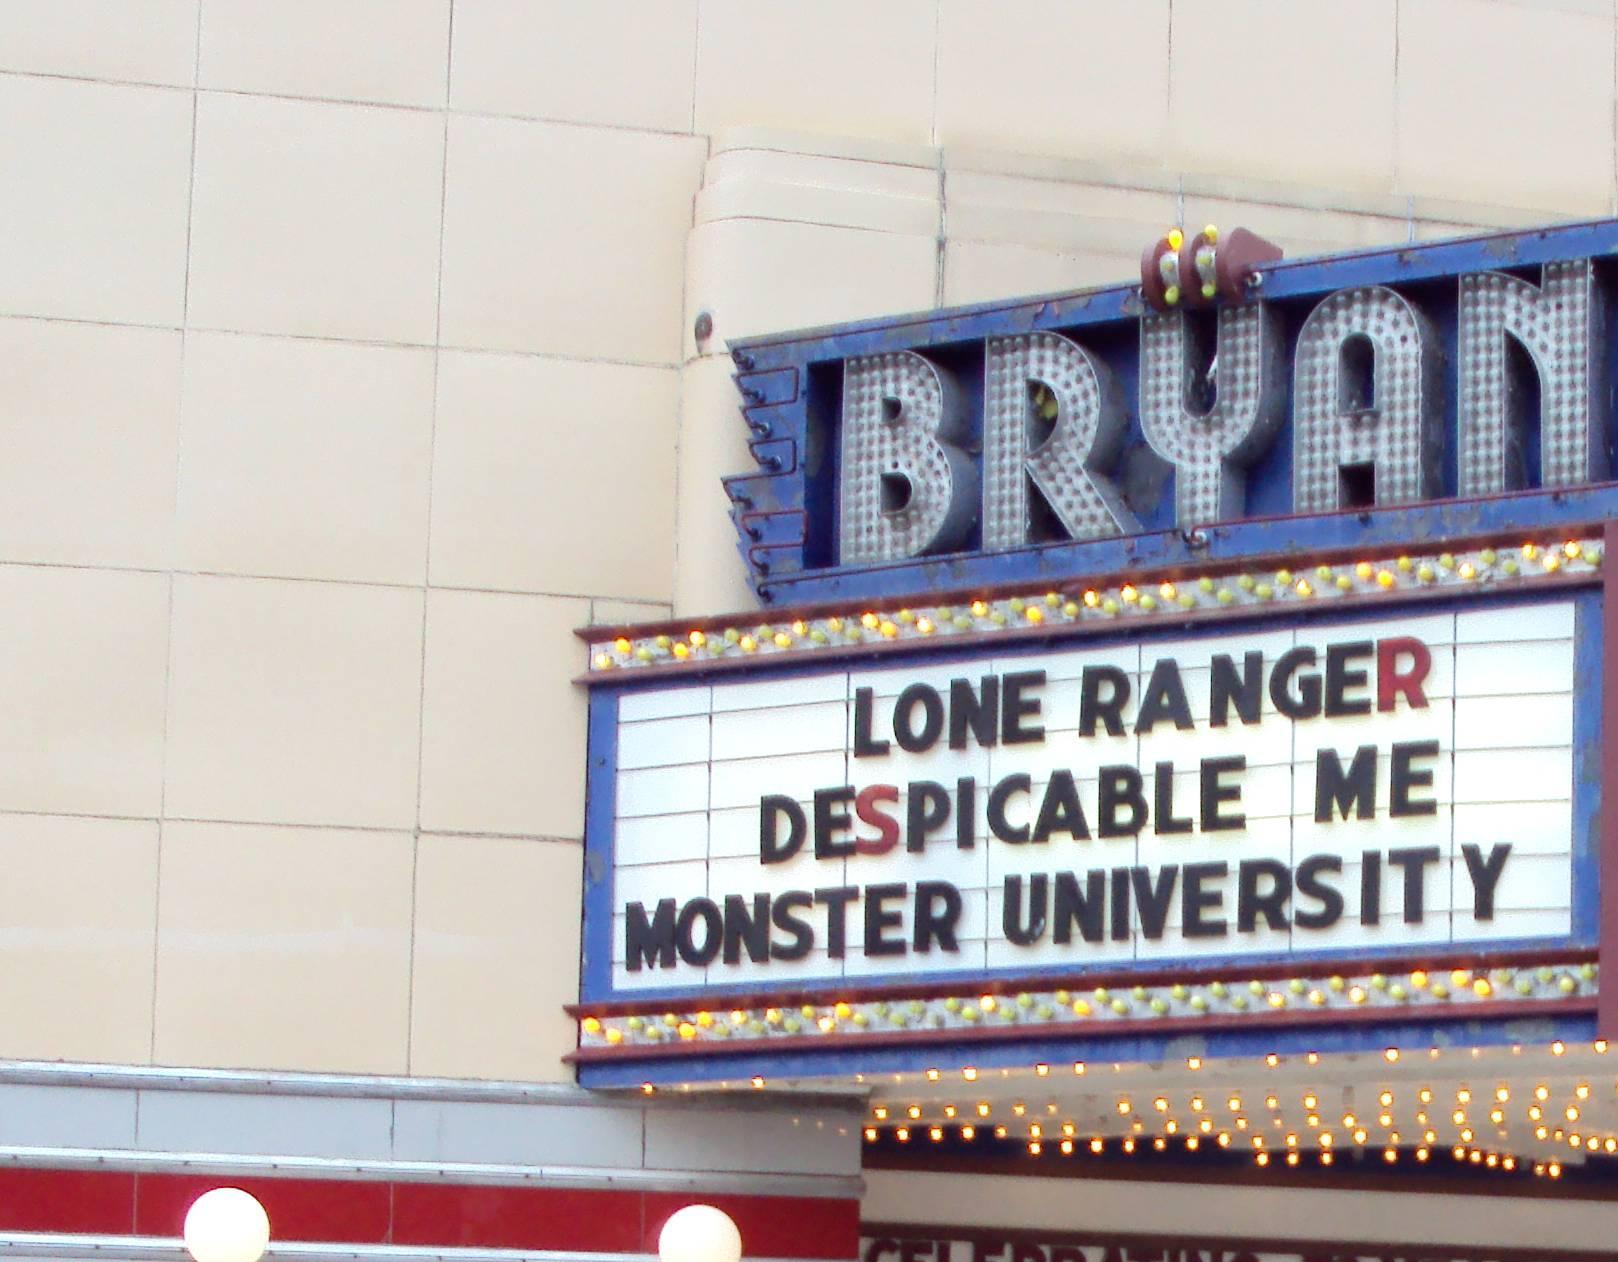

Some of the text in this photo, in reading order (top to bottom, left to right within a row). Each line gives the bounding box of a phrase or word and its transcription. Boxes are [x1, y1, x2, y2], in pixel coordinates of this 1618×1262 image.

[840, 259, 1594, 566] BRYAN
[853, 636, 1432, 758] LONE RANGER
[759, 739, 1440, 865] DESPICABLE ME
[625, 842, 1513, 971] MONSTER UNIVERSITY
